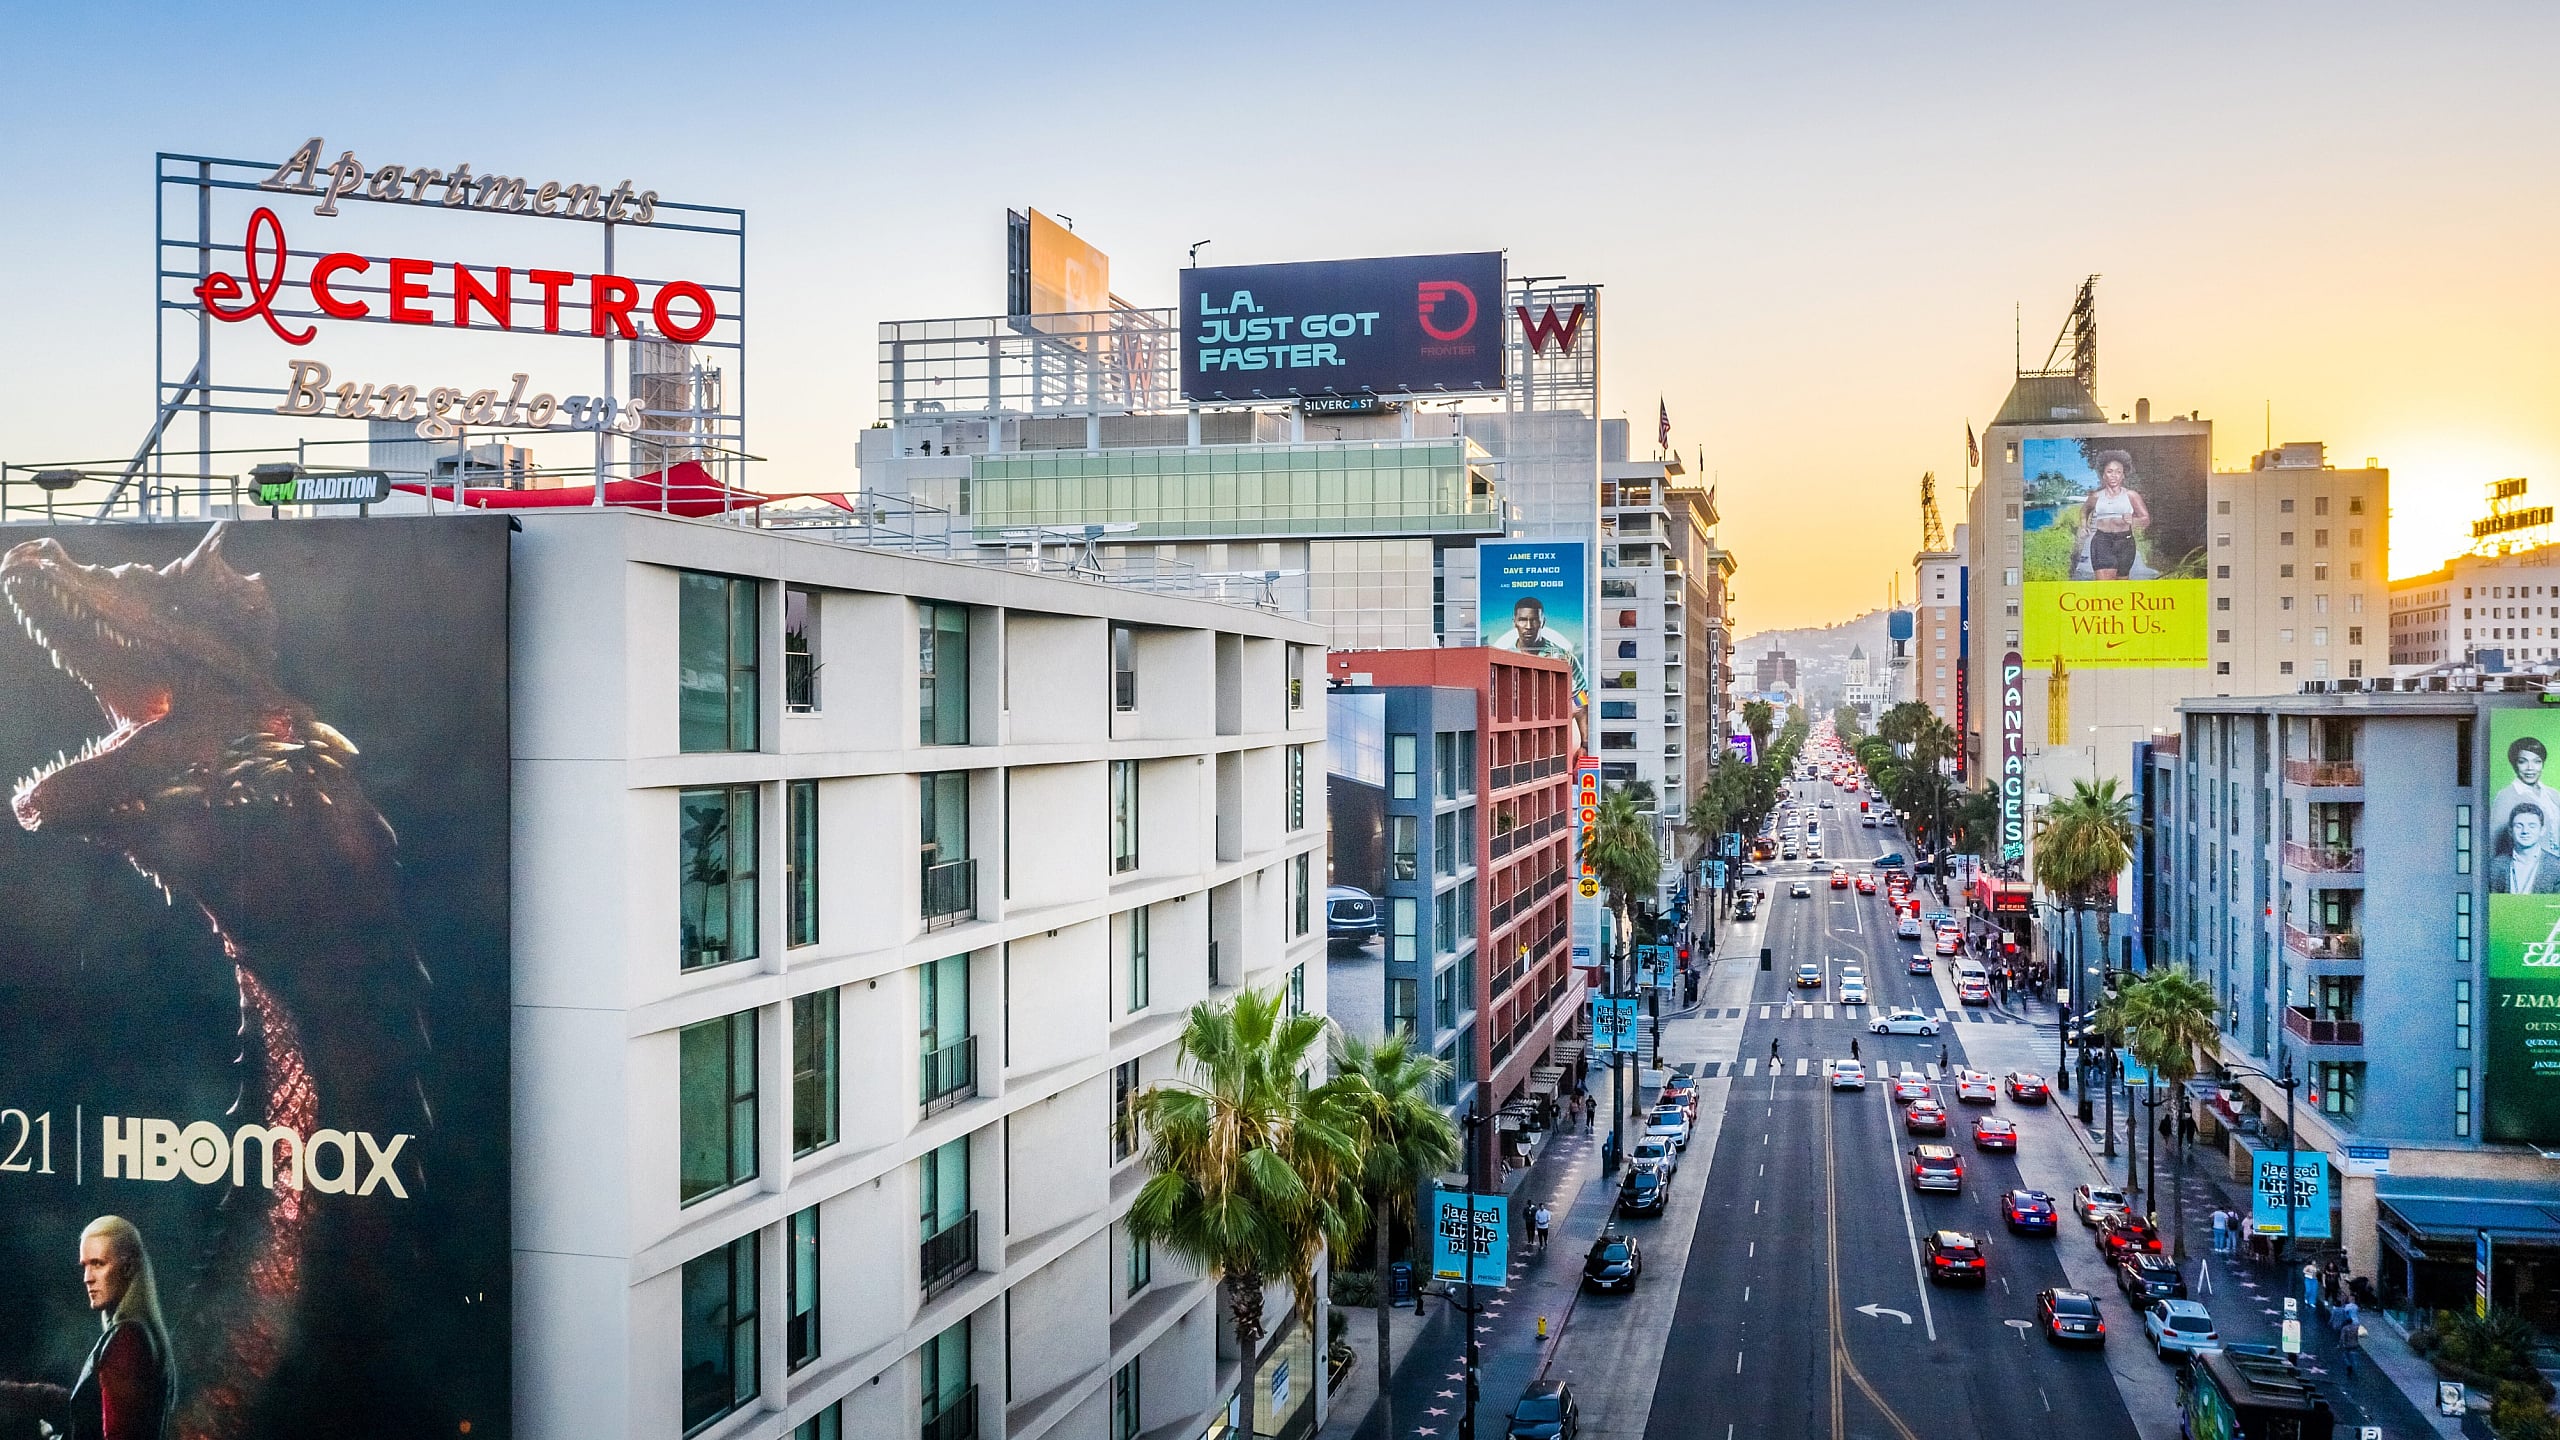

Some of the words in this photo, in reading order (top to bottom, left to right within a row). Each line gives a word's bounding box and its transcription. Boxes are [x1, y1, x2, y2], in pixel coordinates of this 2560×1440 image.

[259, 136, 659, 224] Apartments
[193, 206, 317, 345] el
[310, 252, 716, 343] CENTRO
[1199, 291, 1264, 315] L.A.
[1197, 316, 1294, 343] JUST
[1300, 311, 1380, 338] GOT
[1516, 304, 1586, 357] W
[1199, 343, 1346, 372] FASTER.
[276, 359, 647, 440] Bungalows
[1533, 552, 1556, 560] FOXX
[1525, 566, 1560, 574] FRANCO
[2059, 592, 2124, 612] Come
[2130, 591, 2175, 611] Run
[2071, 615, 2124, 635] With
[2132, 614, 2166, 635] Us.
[1711, 707, 1719, 760] BLDG
[2004, 666, 2022, 841] PANTAGES
[2501, 994, 2511, 1008] 7
[0, 1108, 55, 1174] 21
[2263, 1162, 2319, 1179] jagged
[2260, 1178, 2317, 1196] little
[2270, 1195, 2309, 1209] pill
[1443, 1205, 1498, 1223] jagged
[1440, 1220, 1497, 1242] little
[1451, 1240, 1488, 1255] pill
